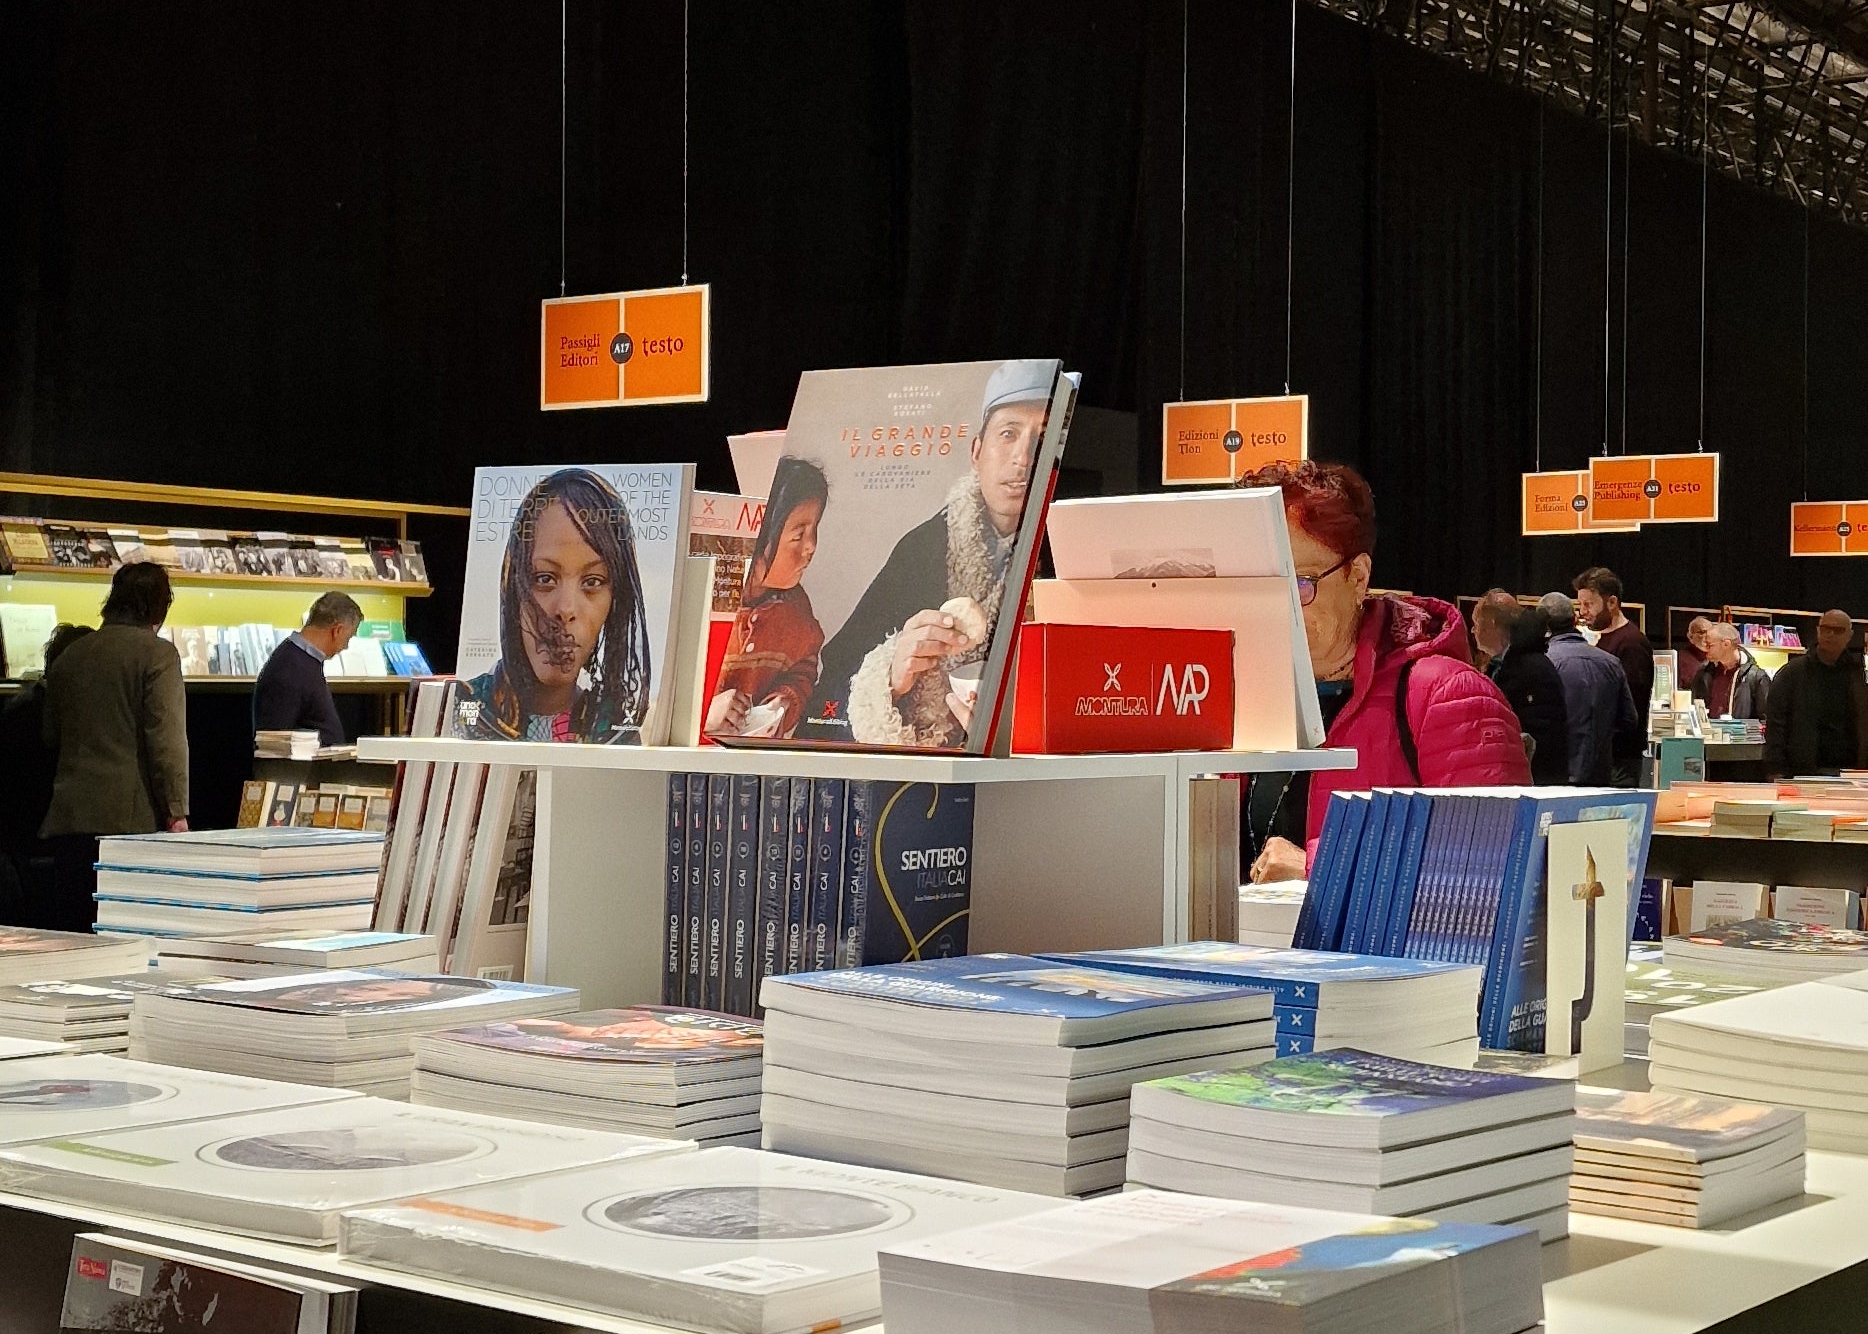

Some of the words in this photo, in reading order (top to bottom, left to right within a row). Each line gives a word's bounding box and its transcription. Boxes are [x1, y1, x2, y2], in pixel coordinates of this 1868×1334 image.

[560, 333, 600, 351] Passigli
[614, 342, 630, 354] A17
[642, 335, 684, 357] testo
[560, 351, 598, 368] Editori
[841, 427, 862, 442] IL
[871, 422, 971, 442] GRANDE
[1178, 429, 1220, 441] Edizioni
[1251, 431, 1287, 447] testo
[849, 441, 953, 459] VIAGGIO
[1178, 443, 1201, 455] Tlon
[479, 474, 549, 497] DONNE
[612, 472, 672, 487] WOMEN
[1594, 480, 1643, 493] Emergenze
[1668, 481, 1701, 495] testo
[621, 490, 638, 504] OF
[642, 489, 671, 505] THE
[1535, 495, 1562, 503] Forma
[1593, 490, 1642, 502] Publishing
[477, 499, 494, 519] DI
[577, 507, 671, 524] OUTERMOST
[1535, 503, 1568, 513] Edizioni
[617, 525, 669, 542] LANDS
[1075, 696, 1149, 716] MONTURA
[900, 846, 967, 872] SENTIERO
[669, 914, 679, 973] SENTIERO
[690, 915, 700, 975] SENTIERO
[710, 918, 721, 979] SENTIERO
[734, 919, 745, 979] SENTIERO
[1511, 1001, 1530, 1018] ALLE
[1508, 1016, 1531, 1033] DELLA
